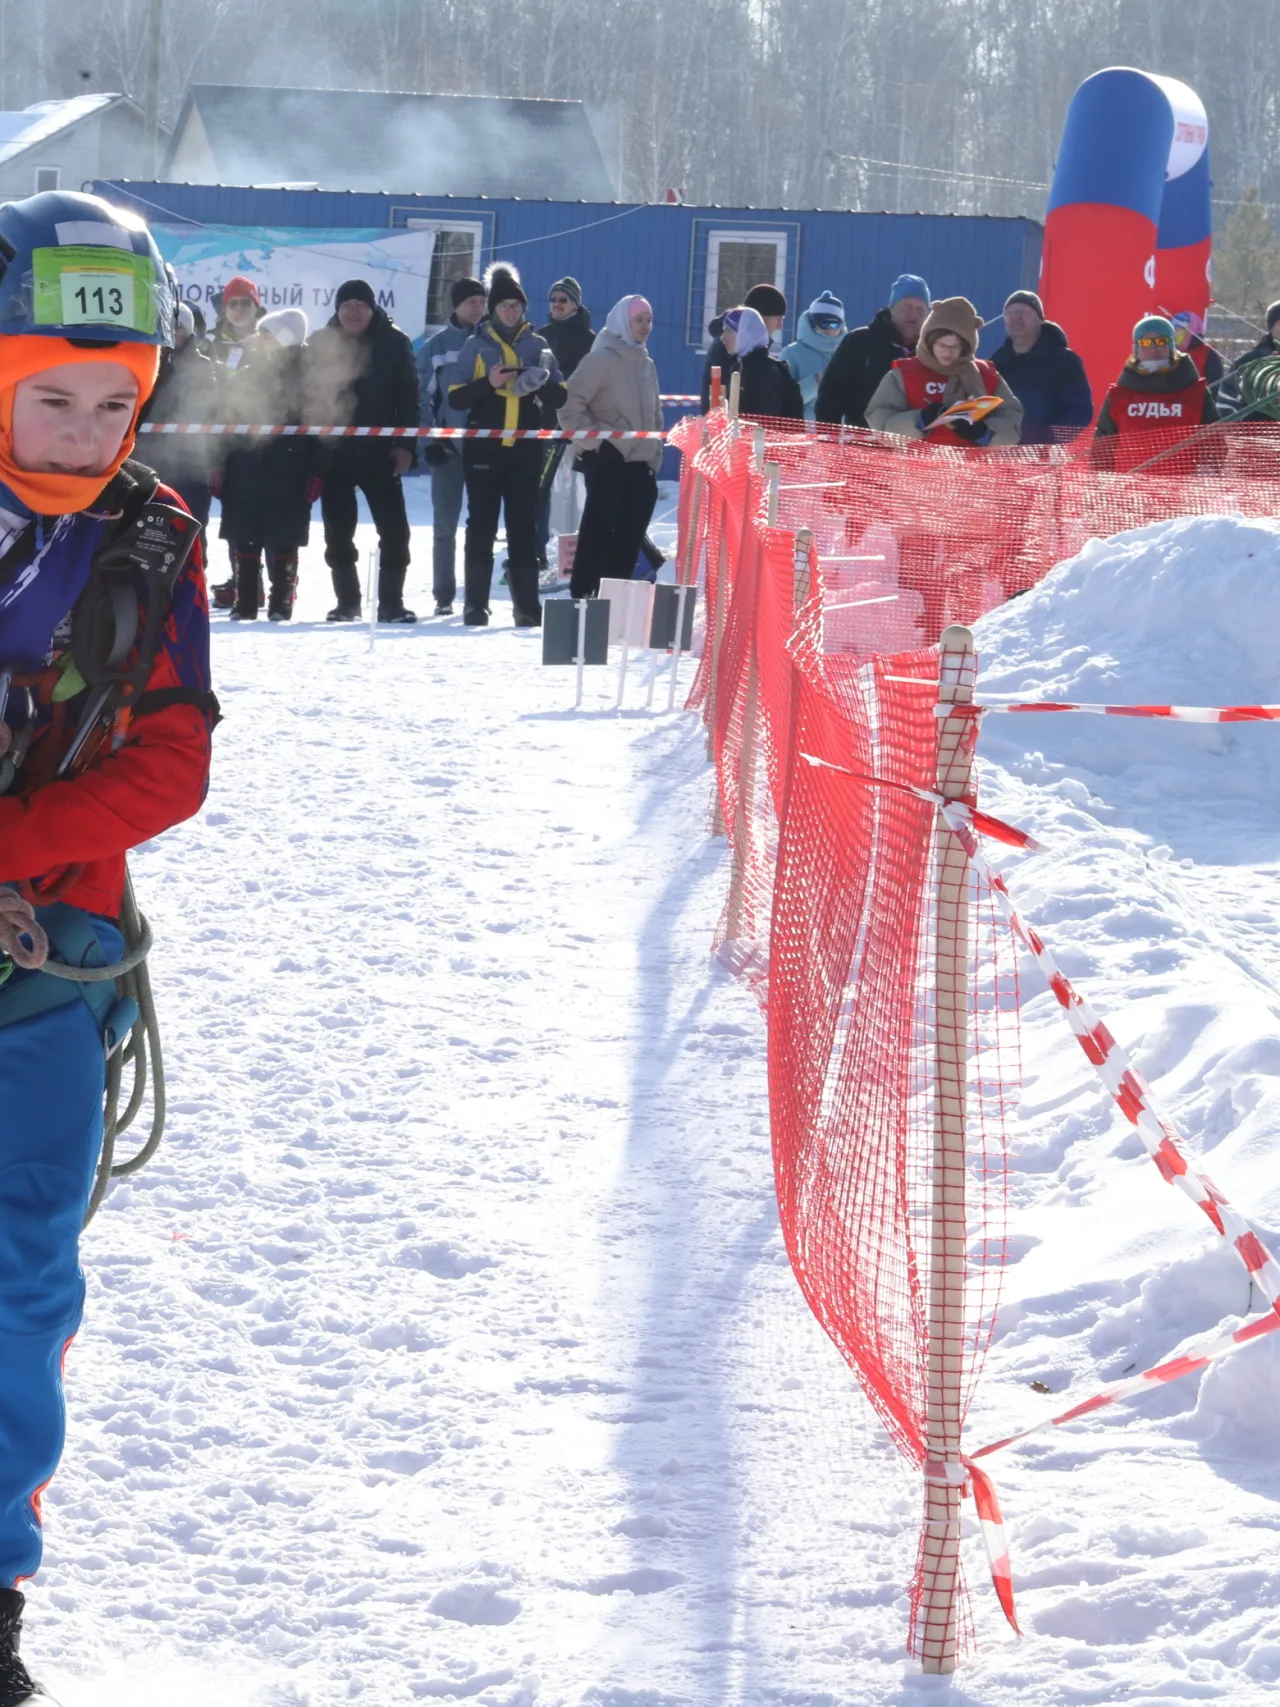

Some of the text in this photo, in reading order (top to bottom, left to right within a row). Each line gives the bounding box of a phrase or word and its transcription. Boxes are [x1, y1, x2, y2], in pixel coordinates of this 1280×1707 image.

[74, 286, 124, 316] 113
[177, 283, 395, 308] ПОРНЫЙ ТУМ
[1127, 402, 1182, 419] СУДЬЯ
